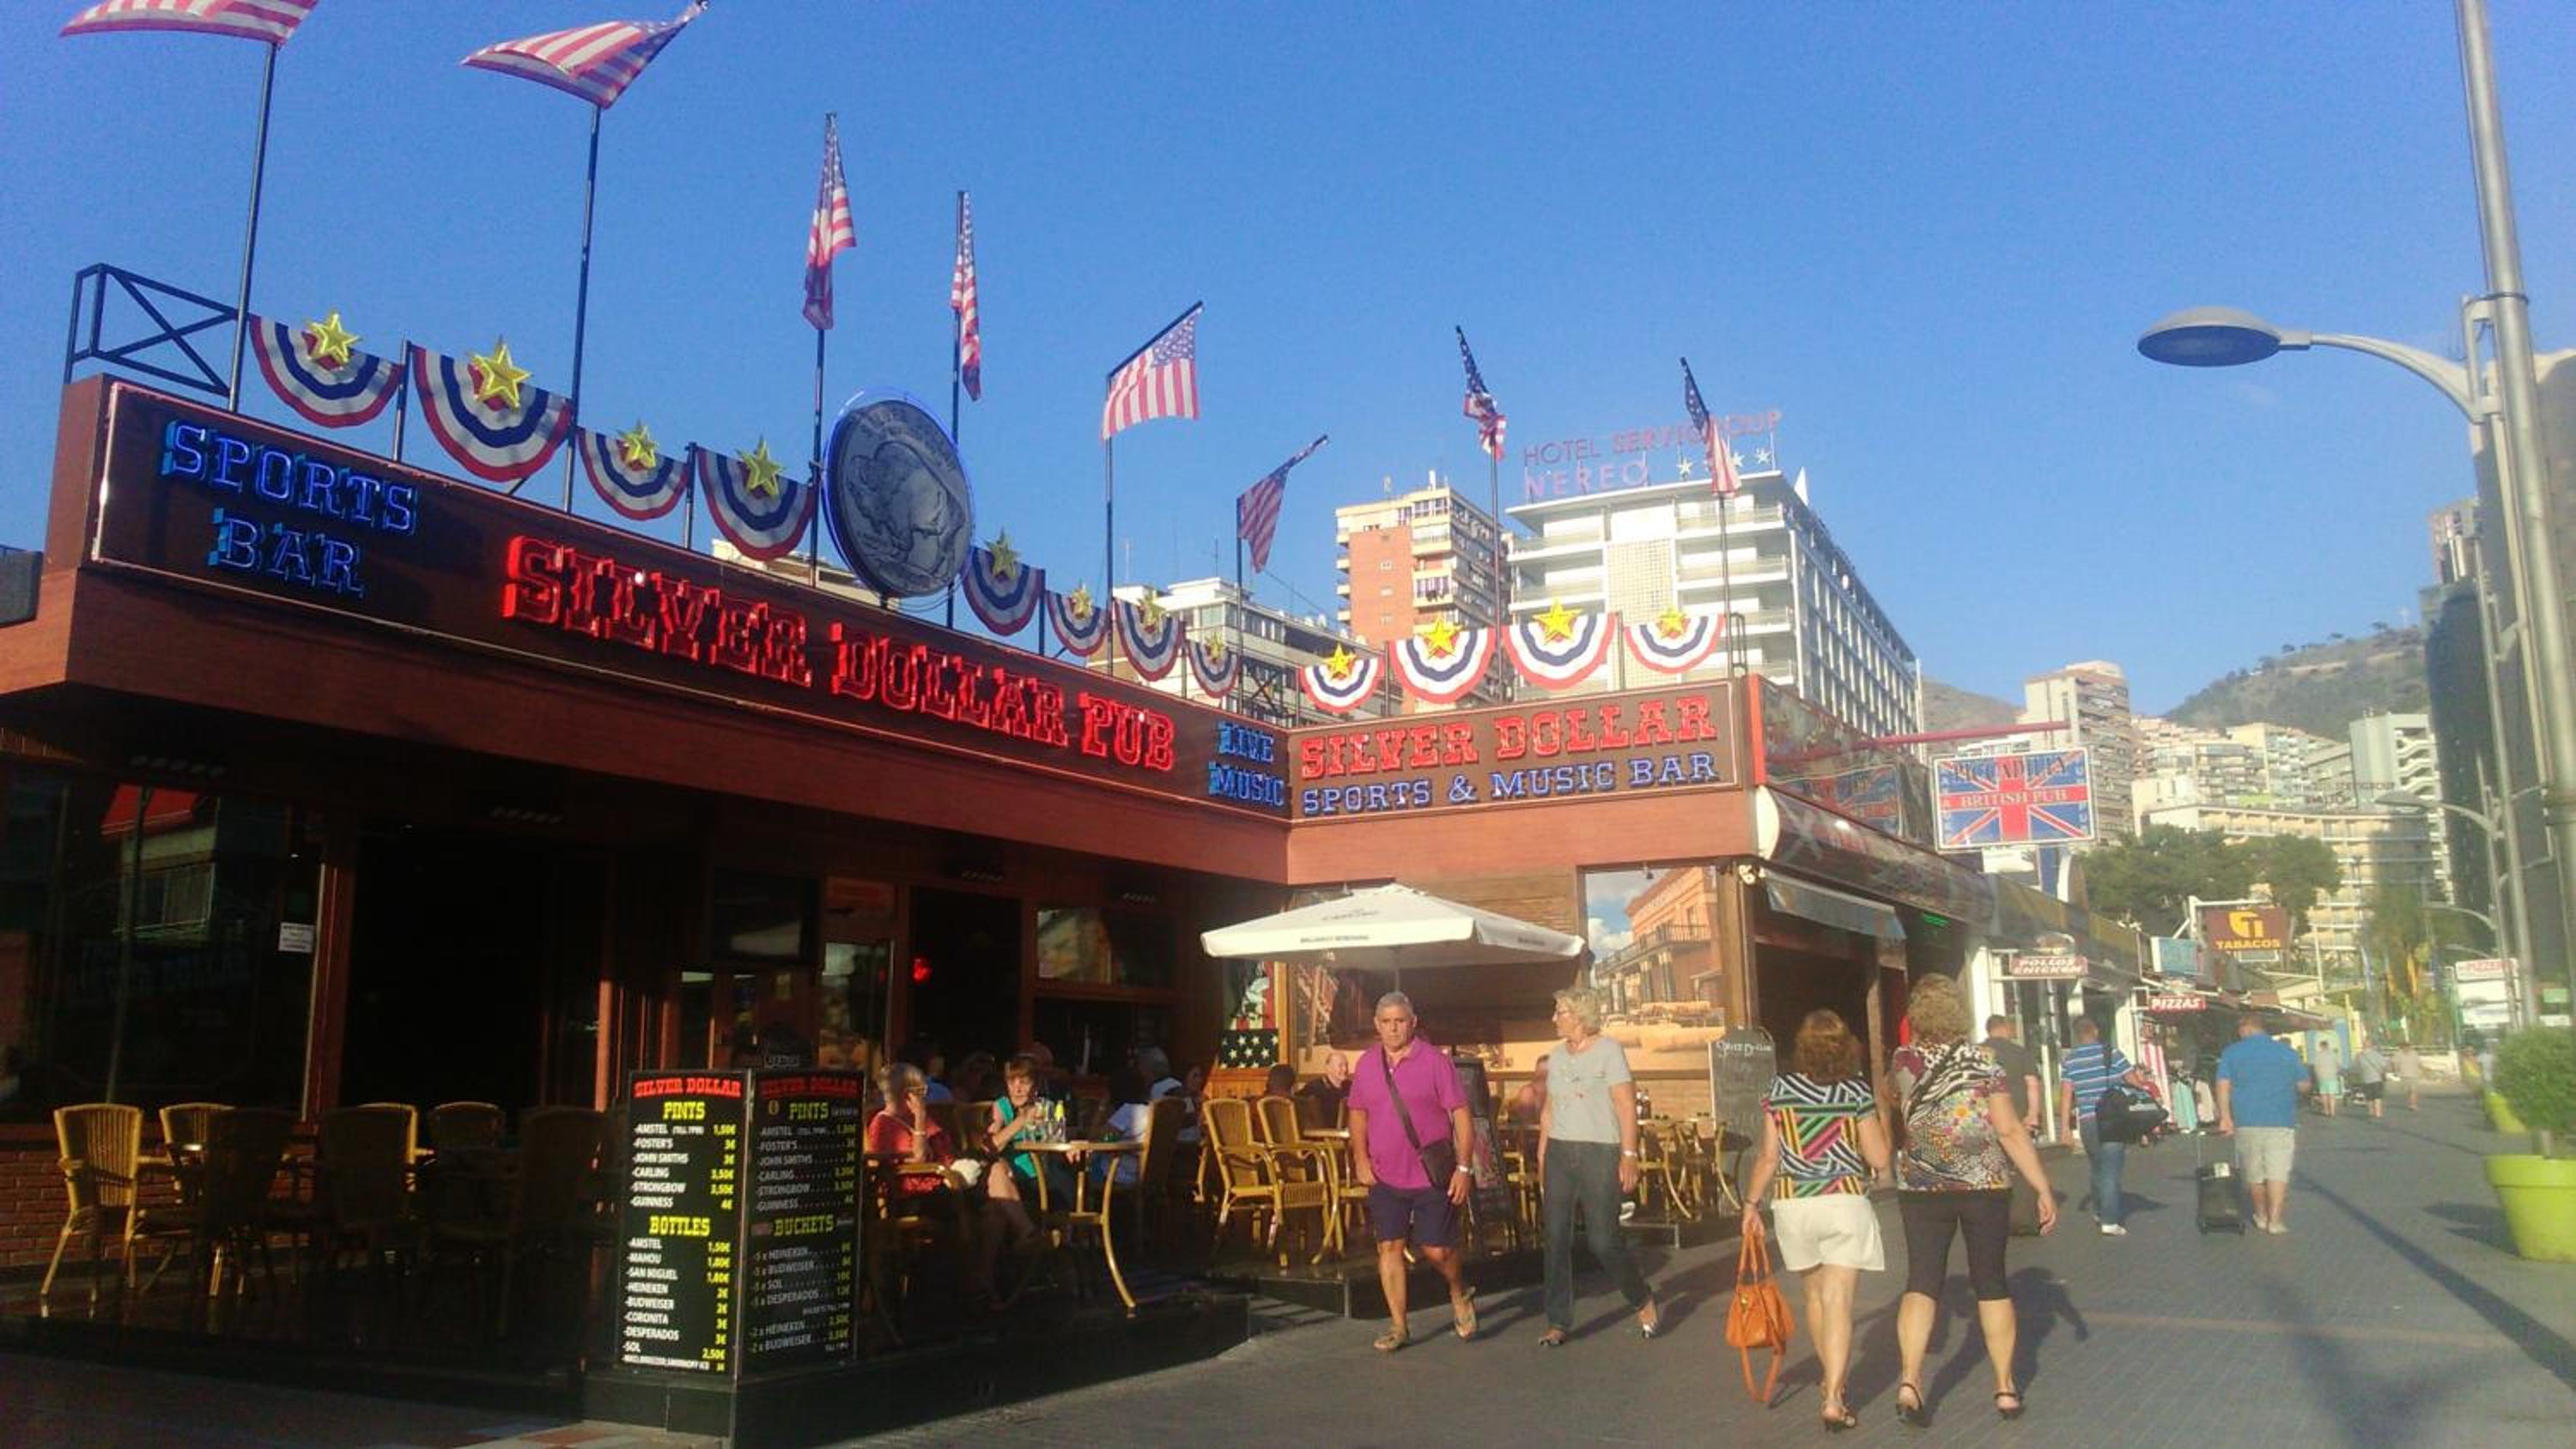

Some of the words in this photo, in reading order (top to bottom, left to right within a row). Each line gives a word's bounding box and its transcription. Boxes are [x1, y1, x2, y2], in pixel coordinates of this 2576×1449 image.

[1524, 439, 1601, 466] HOTEL
[162, 417, 417, 536] SPORTS
[1524, 459, 1649, 498] NEREO
[208, 507, 365, 597] BAR
[501, 536, 811, 688] SILVER
[830, 621, 1068, 747] DOLLAR
[1078, 692, 1175, 771] PUB
[1218, 720, 1275, 763] LIVE
[1299, 720, 1479, 780] SILVER
[1495, 694, 1718, 761] DOLLAR
[1209, 761, 1285, 808] MUSIC
[1302, 779, 1433, 816] SPORTS
[1449, 775, 1477, 803] &
[1491, 762, 1615, 799] MUSIC
[1628, 753, 1716, 787] BAR
[1960, 791, 2027, 808] BRITISH
[2032, 789, 2069, 803] PUB
[2215, 939, 2281, 950] TABACOS
[2019, 958, 2075, 967] POLLOS
[2150, 997, 2201, 1010] PIZZAS
[634, 1077, 683, 1099] SILVER
[686, 1076, 742, 1098] DOLLAR
[663, 1100, 706, 1120] PINTS
[788, 1101, 829, 1120] PINTS
[648, 1216, 711, 1237] BOTTLES
[774, 1215, 835, 1237] BUCKETS
[767, 1278, 783, 1291] SOL
